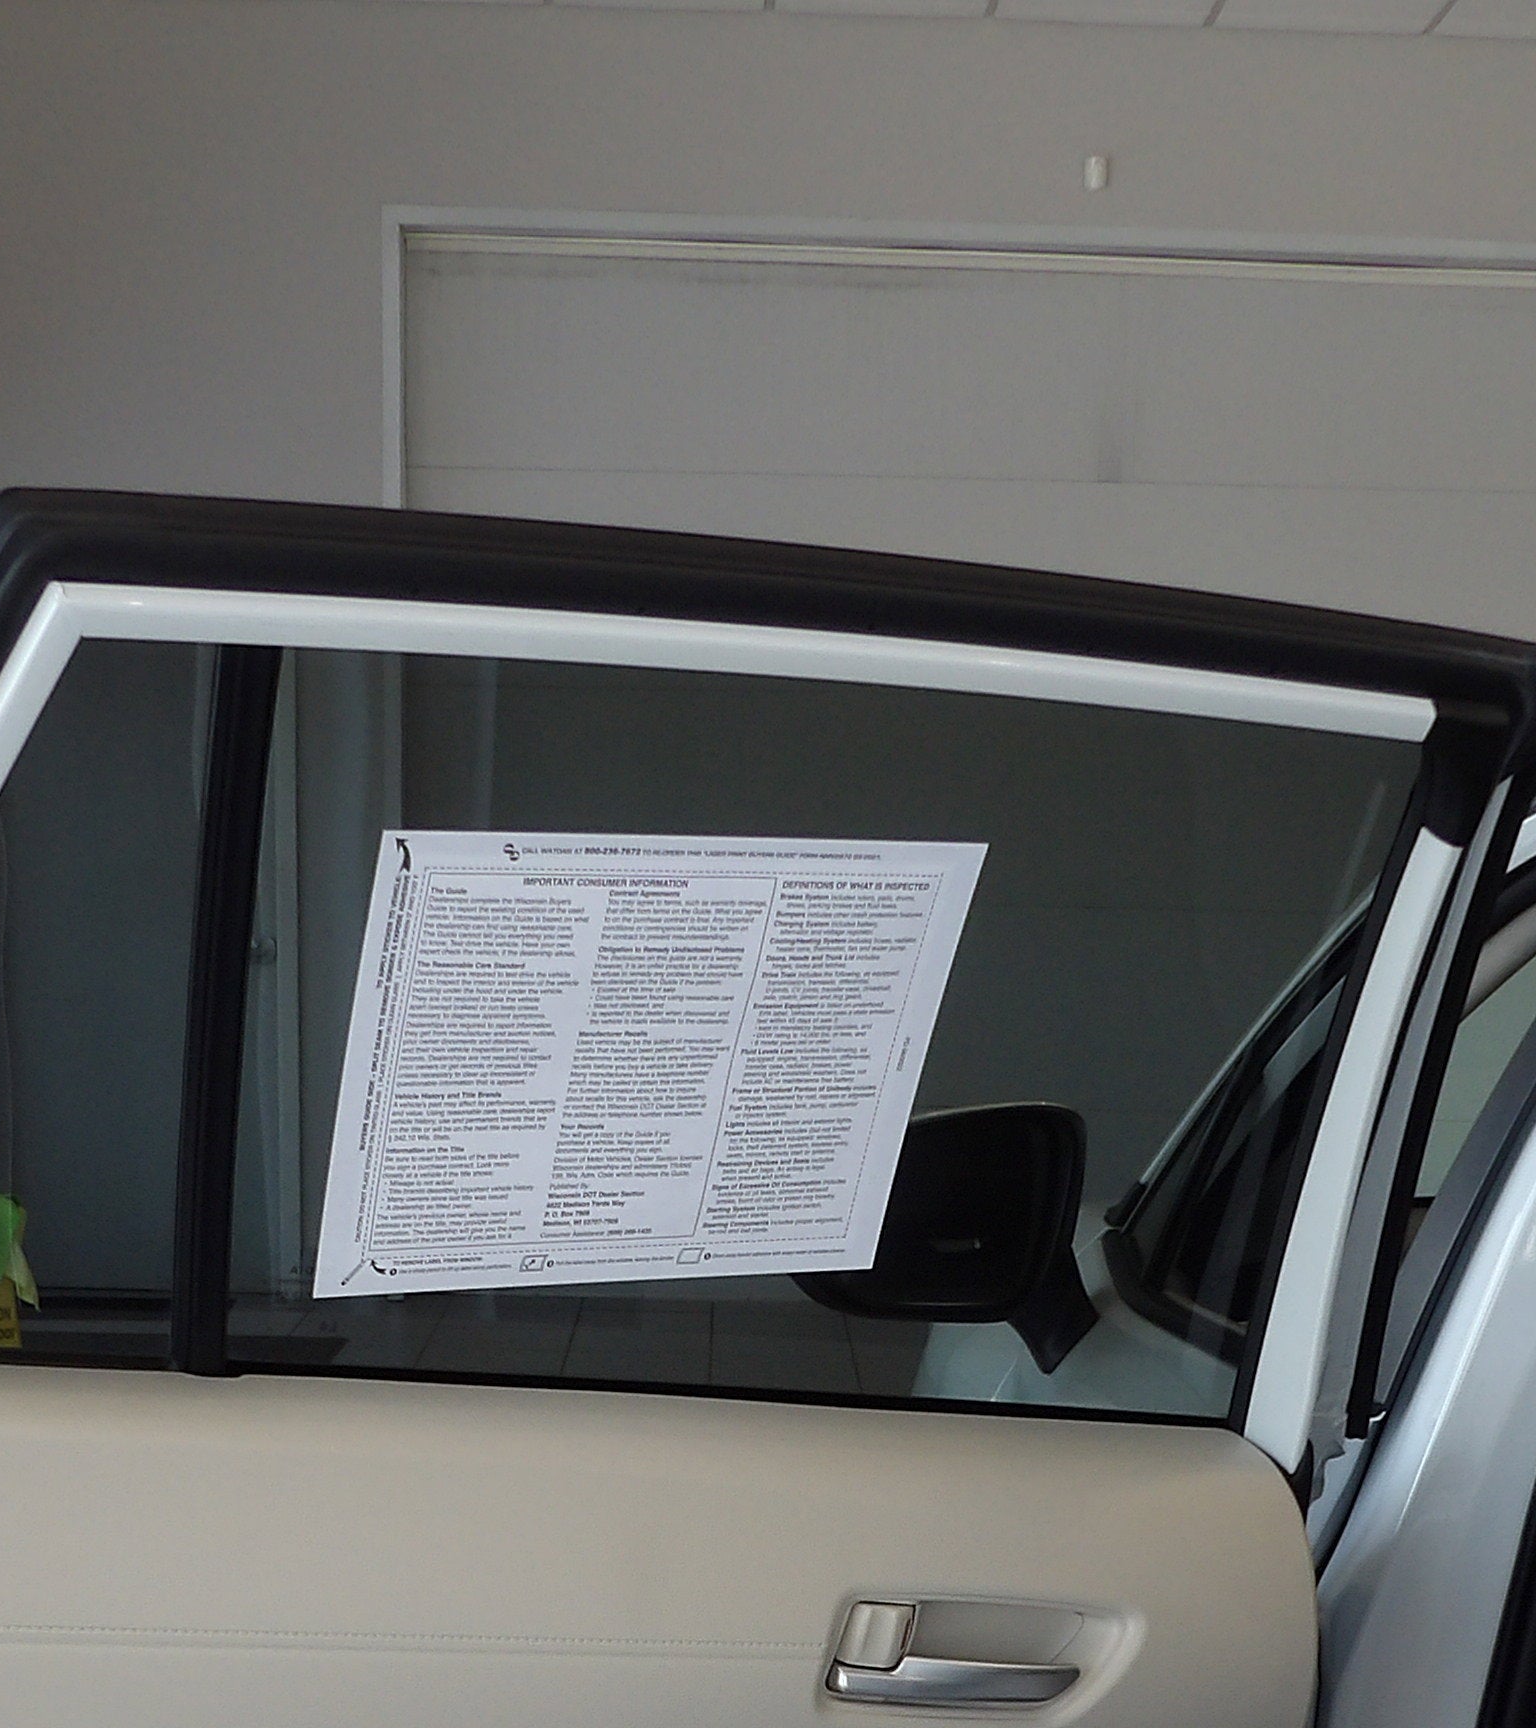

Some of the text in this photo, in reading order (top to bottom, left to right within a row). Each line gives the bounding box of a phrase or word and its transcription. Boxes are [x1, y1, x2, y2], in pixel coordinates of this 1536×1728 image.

[523, 877, 689, 889] IMPORTANT CONSUMER INFORMATION
[782, 880, 930, 892] DEFINITIONS OF WHAT IS INSPECTED
[430, 887, 467, 896] The Guide
